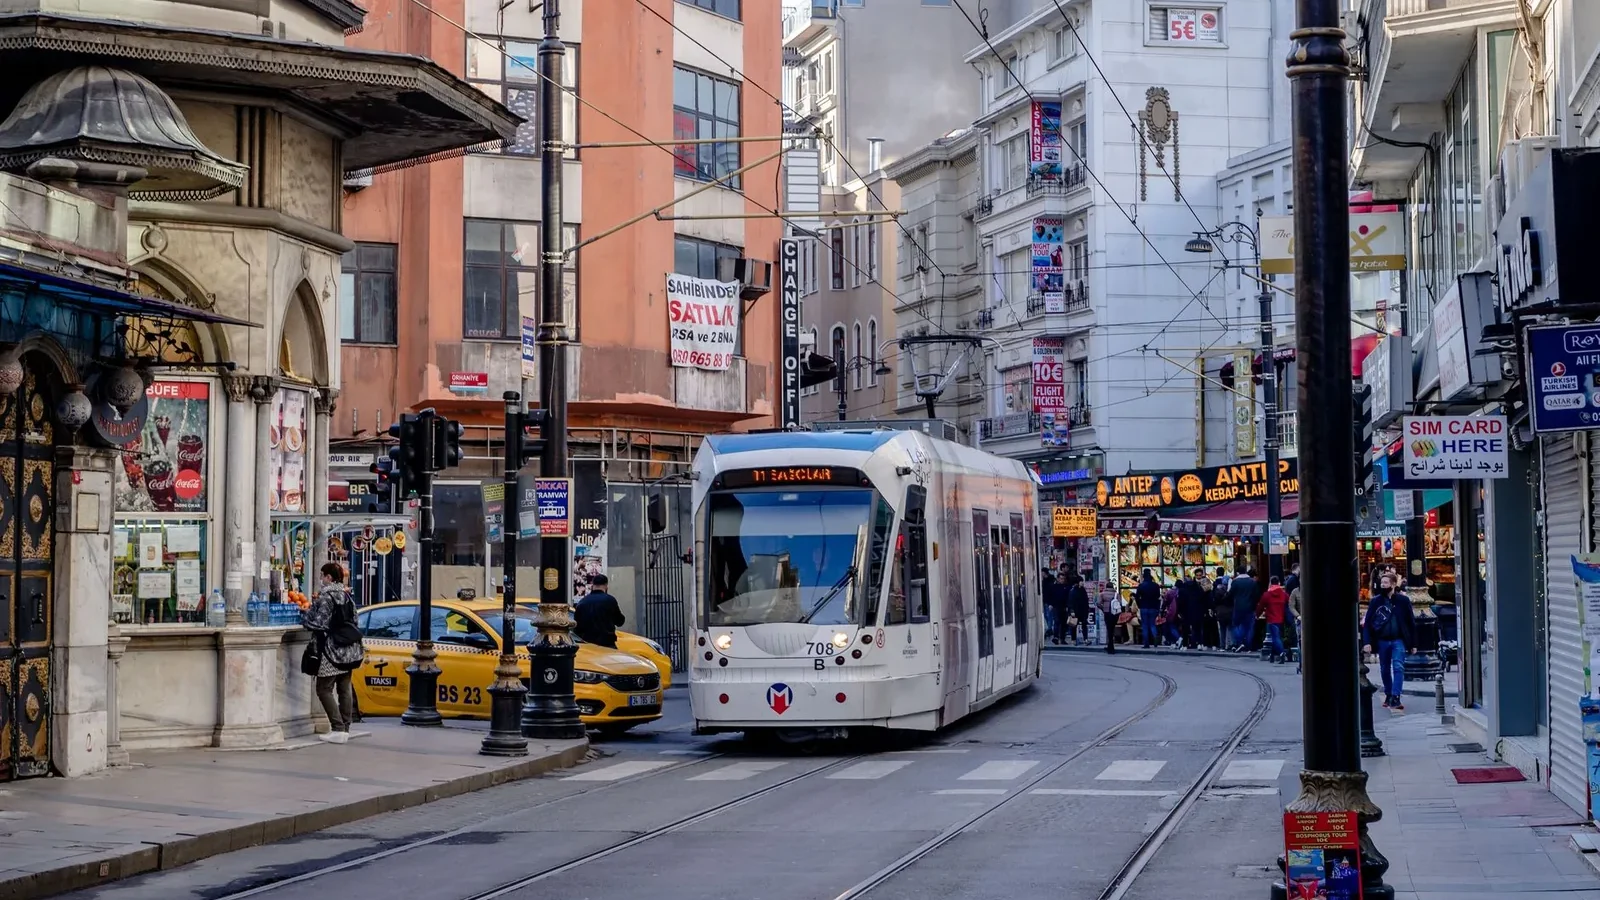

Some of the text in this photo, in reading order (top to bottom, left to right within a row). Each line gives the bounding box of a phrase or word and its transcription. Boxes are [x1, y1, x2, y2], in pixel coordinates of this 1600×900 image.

[1171, 20, 1196, 40] 5€
[1272, 230, 1291, 239] The
[784, 242, 797, 338] CHANGE
[698, 334, 708, 342] ve
[1576, 356, 1588, 366] All
[1034, 364, 1062, 382] 10€
[1543, 376, 1576, 384] TURKISH
[1036, 386, 1062, 396] FLIGHT
[1544, 383, 1576, 391] AIRLINES
[1034, 396, 1064, 406] TICKETS
[1546, 398, 1572, 406] QATAR
[1410, 420, 1502, 436] SIM CARD
[1442, 439, 1503, 454] HERE
[1449, 458, 1472, 474] لدينا
[1477, 460, 1504, 473] يوجد
[536, 481, 568, 490] DİKKAT
[1114, 476, 1154, 494] ANTEP
[1109, 496, 1127, 508] KEBAP
[1055, 508, 1096, 516] ANTEP
[580, 518, 600, 530] HER
[806, 642, 834, 656] 708
[814, 658, 825, 670] B
[464, 686, 481, 704] 23
